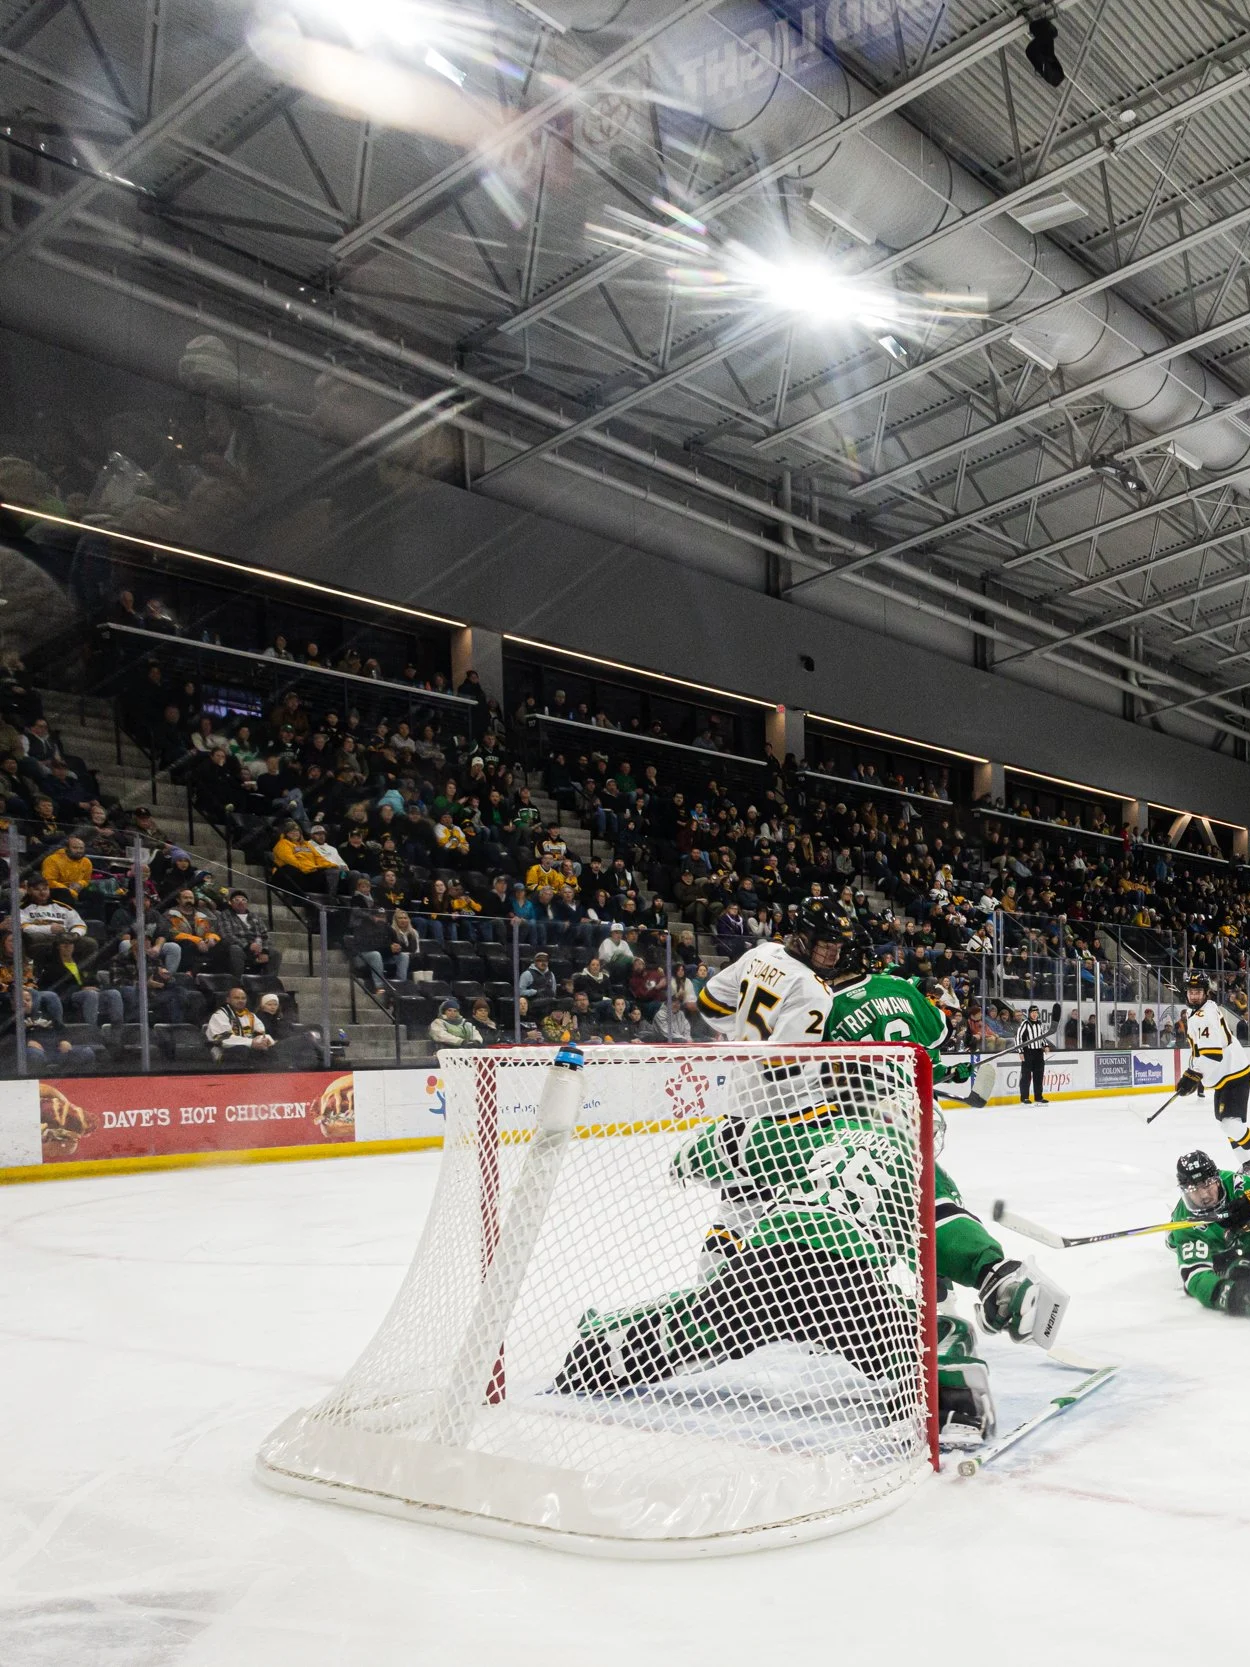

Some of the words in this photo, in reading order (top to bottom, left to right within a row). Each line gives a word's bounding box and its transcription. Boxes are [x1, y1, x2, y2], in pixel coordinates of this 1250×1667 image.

[746, 957, 787, 988] STUART
[831, 997, 914, 1042] STRATHMANN
[1198, 1026, 1210, 1039] 14
[1100, 1057, 1127, 1065] FOUNTAIN
[1102, 1067, 1124, 1075] COLONY
[1147, 1070, 1161, 1078] Range
[102, 1108, 171, 1129] DAVE'S
[180, 1106, 217, 1124] HOT
[225, 1102, 306, 1122] CHICKEN
[1182, 1239, 1209, 1261] 29
